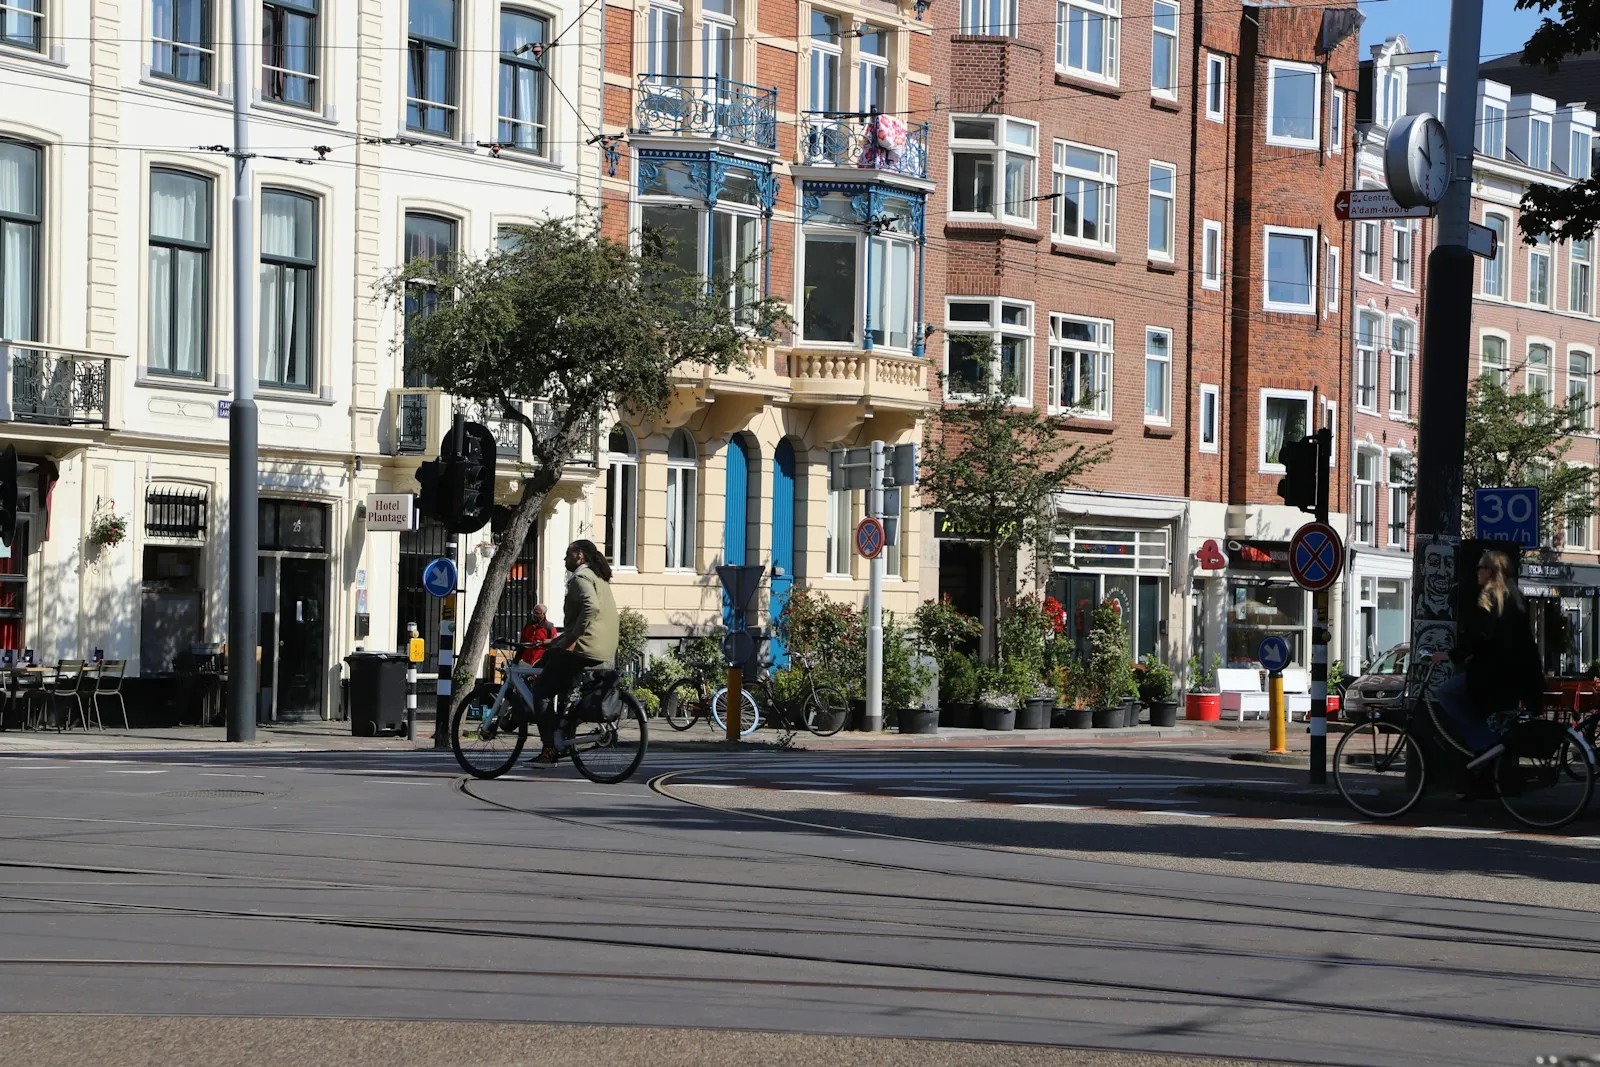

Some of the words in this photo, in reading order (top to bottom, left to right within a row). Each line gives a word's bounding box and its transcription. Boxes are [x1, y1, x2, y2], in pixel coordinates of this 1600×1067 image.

[376, 500, 400, 510] Hotel
[1481, 494, 1532, 523] 30
[368, 512, 407, 524] Plantage
[1483, 528, 1531, 541] km/h
